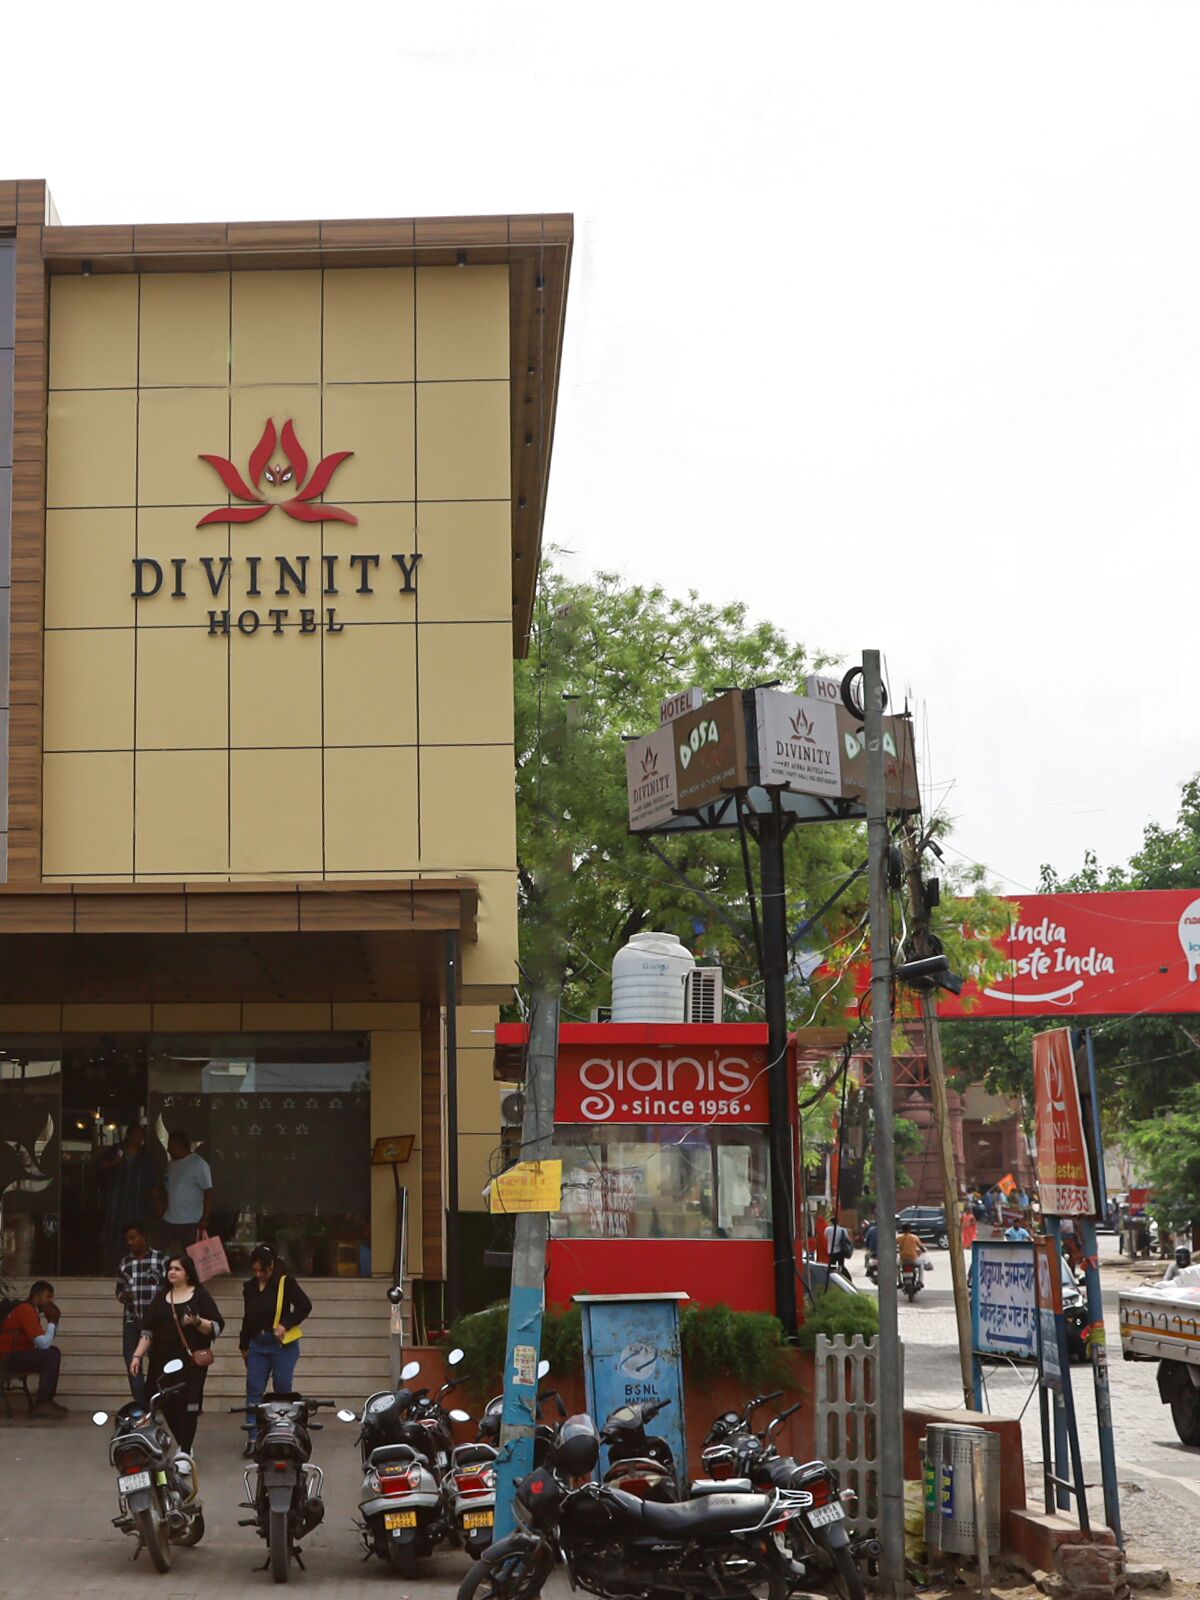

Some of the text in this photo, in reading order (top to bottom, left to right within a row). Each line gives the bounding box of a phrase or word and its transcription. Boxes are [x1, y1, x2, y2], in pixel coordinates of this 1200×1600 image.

[131, 554, 423, 598] DIVINITY
[208, 608, 345, 637] HOTEL
[660, 693, 692, 722] HOTEL
[679, 719, 719, 770] DOSA
[776, 740, 831, 765] DIVINITY
[633, 774, 670, 804] DIVINITY
[1007, 917, 1066, 945] India
[1054, 947, 1116, 976] India
[632, 1096, 741, 1116] since 1956
[625, 1384, 659, 1396] BSNL
